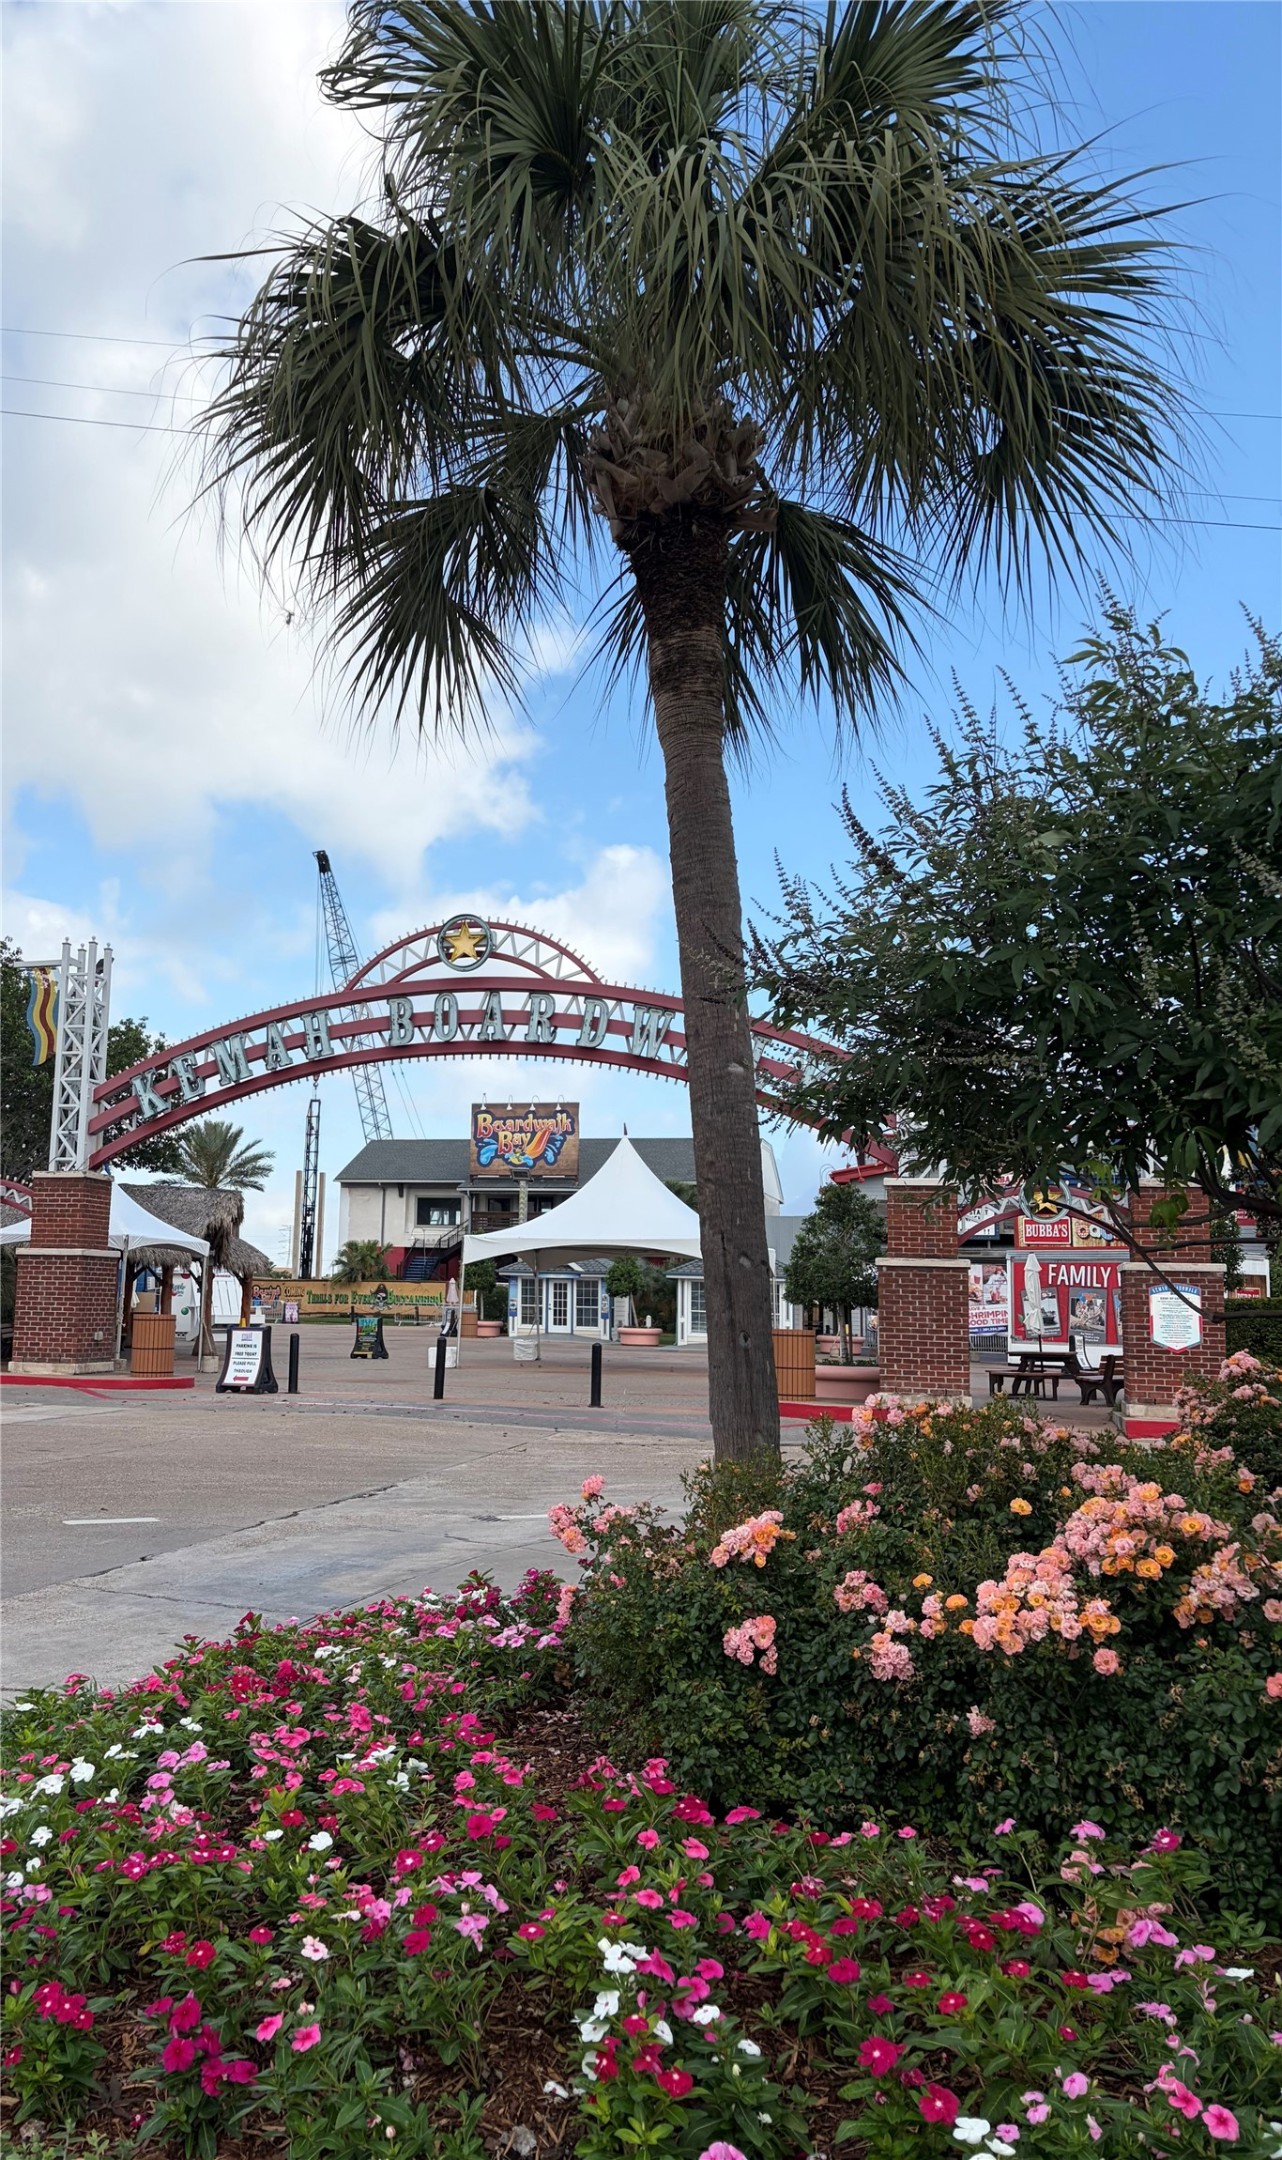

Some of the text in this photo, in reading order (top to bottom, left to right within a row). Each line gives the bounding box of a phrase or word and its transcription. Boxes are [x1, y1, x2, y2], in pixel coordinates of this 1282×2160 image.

[130, 1009, 335, 1119] KEMAH
[477, 1112, 572, 1138] Boardwalk
[498, 1130, 531, 1154] Bay
[1025, 1223, 1068, 1238] BUBBA'S
[1048, 1264, 1111, 1288] FAMILY
